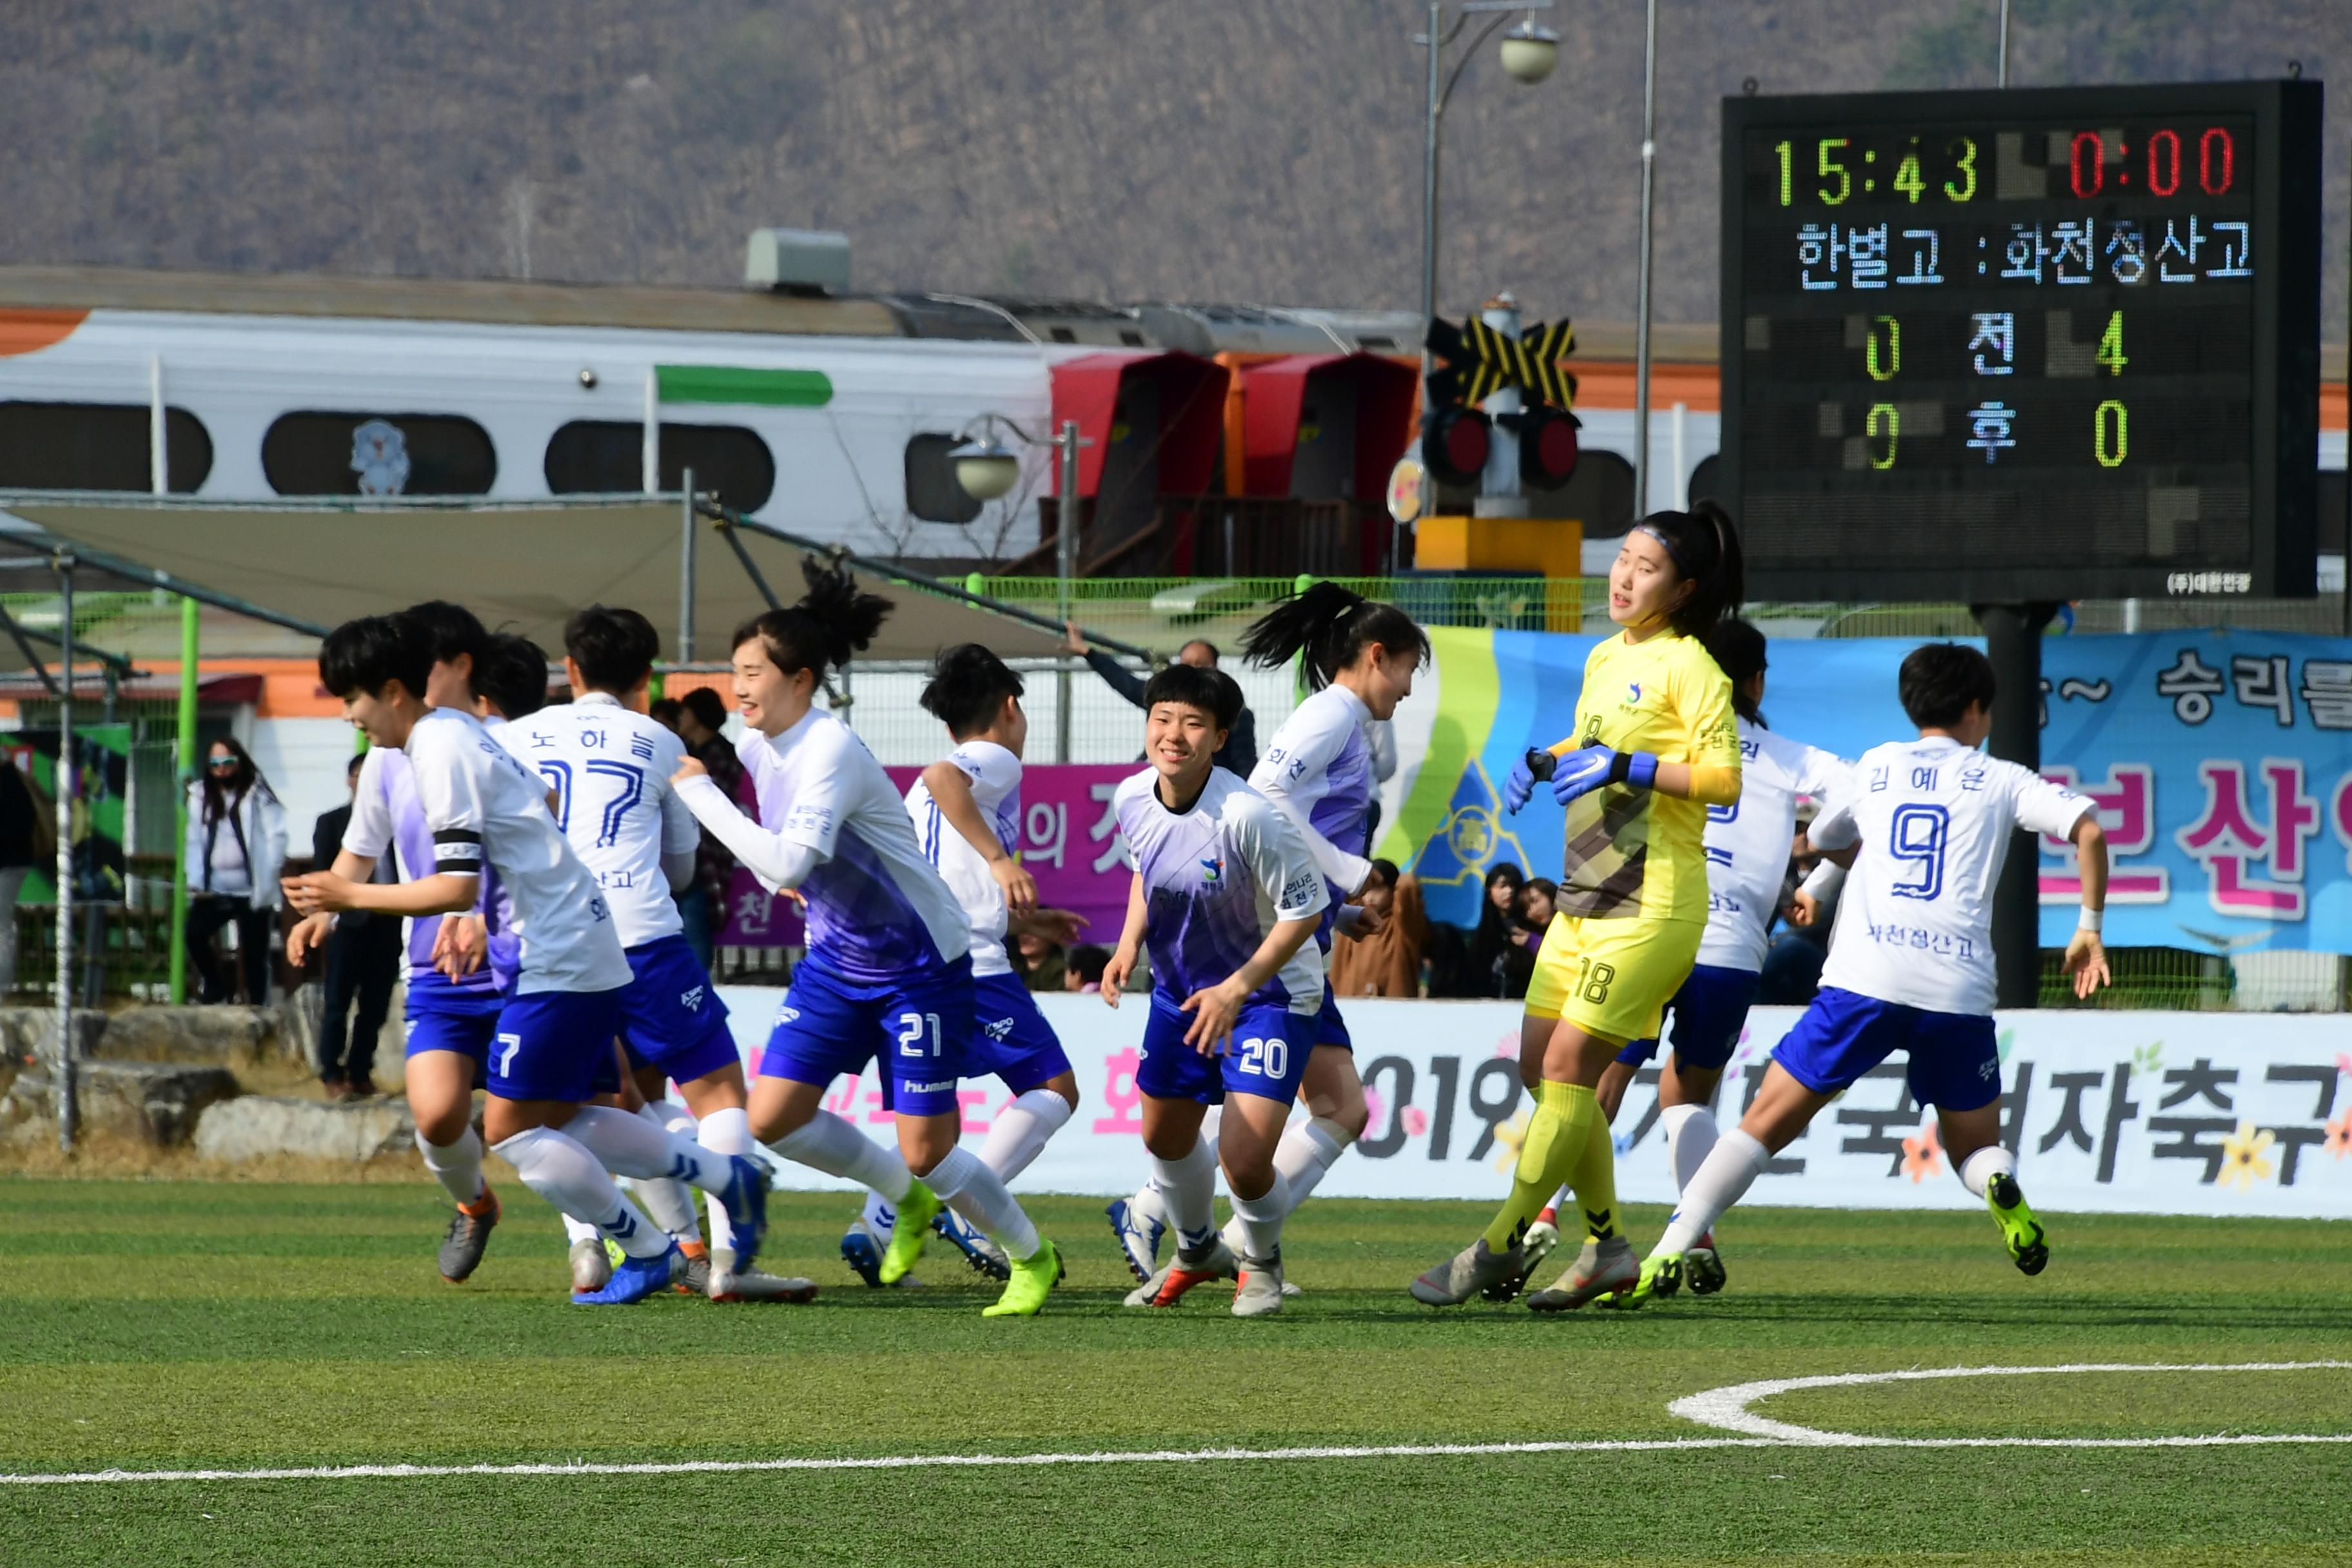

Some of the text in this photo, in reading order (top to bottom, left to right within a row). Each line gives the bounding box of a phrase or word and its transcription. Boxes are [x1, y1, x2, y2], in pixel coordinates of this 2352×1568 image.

[2070, 127, 2233, 199] 0:00
[1797, 223, 1944, 289] 한별고
[2001, 215, 2254, 284] 화천정산고
[1968, 312, 2014, 375] 전
[2095, 310, 2128, 376] 4
[1966, 401, 2016, 464] 후
[2095, 399, 2128, 467] 0
[2156, 648, 2352, 731] 승리를
[538, 759, 644, 848] 17
[1890, 803, 1950, 901] 9
[2039, 756, 2352, 922] 보산
[1574, 957, 1615, 1004] 18
[496, 1032, 521, 1079] 7
[899, 1013, 941, 1057] 21
[1239, 1037, 1288, 1080] 20
